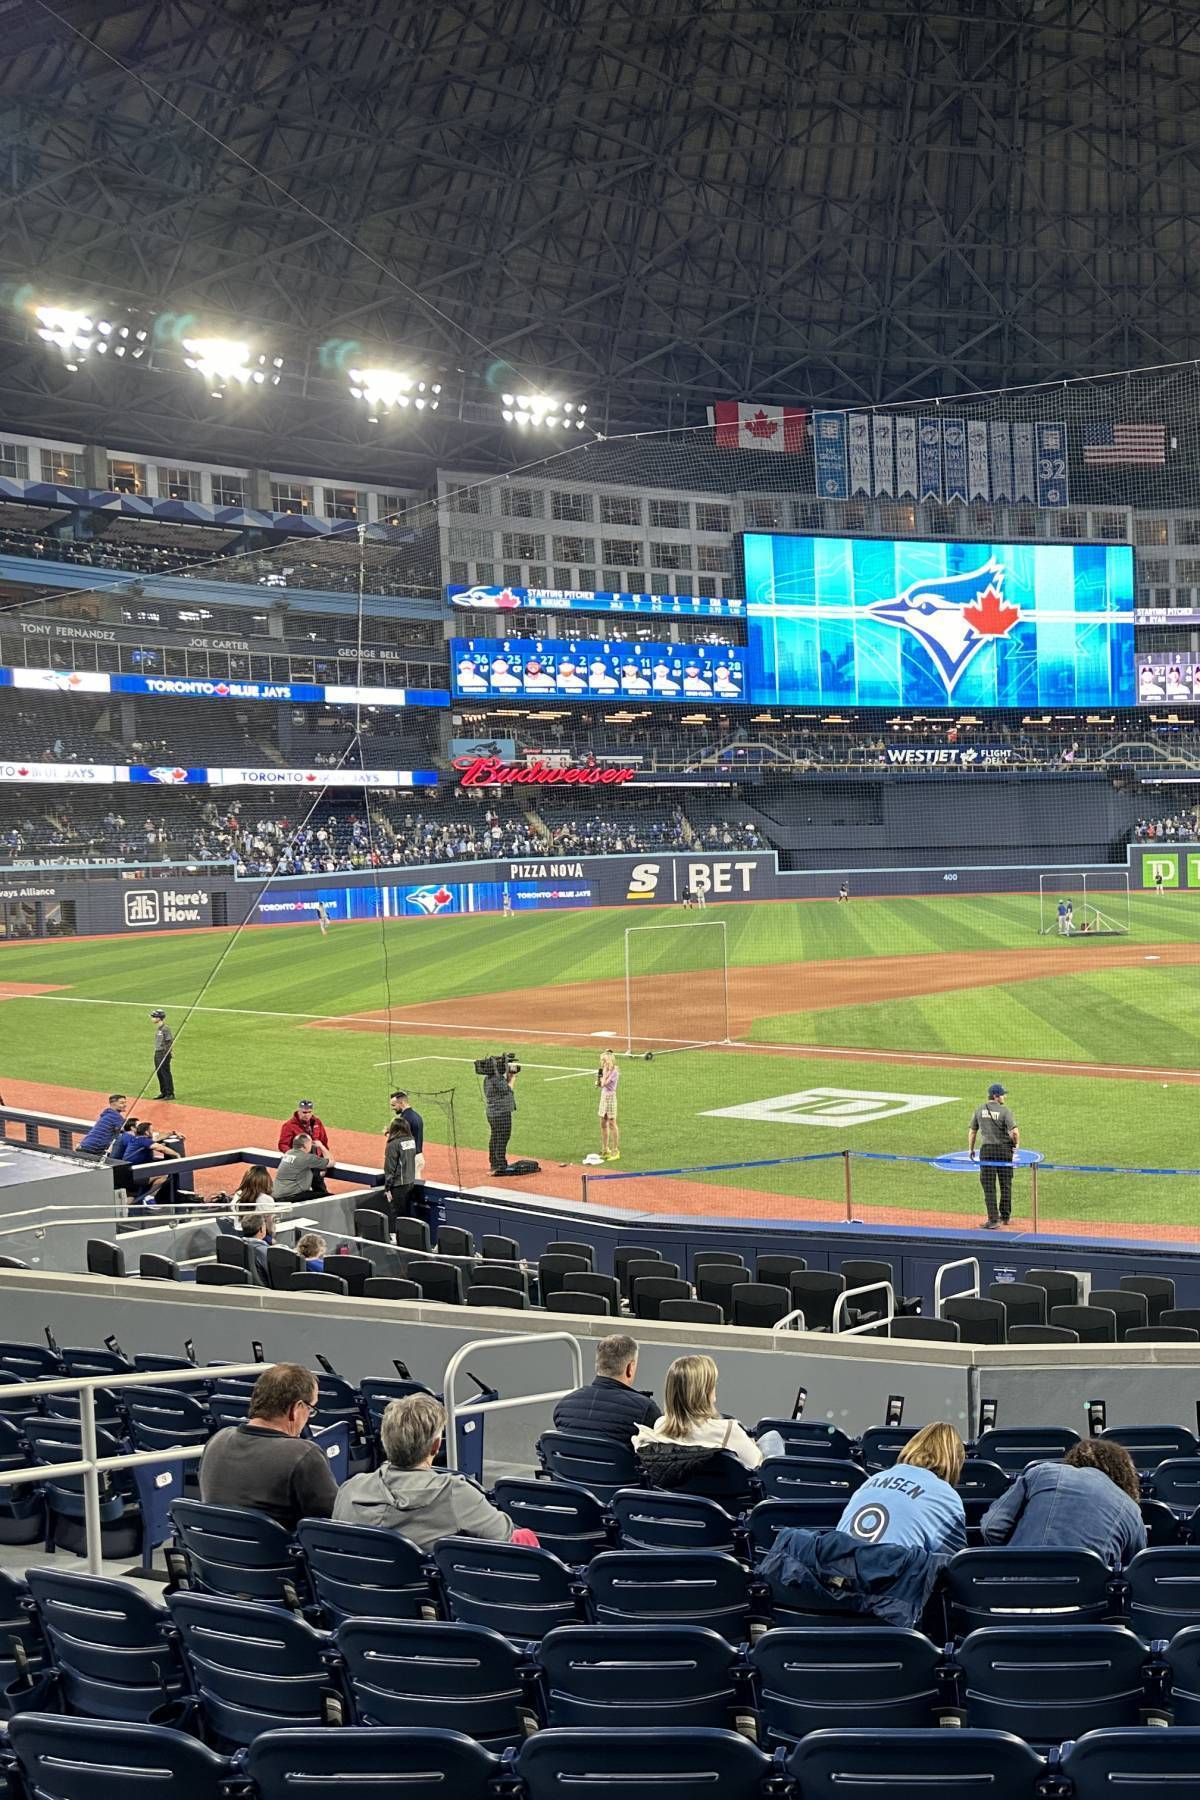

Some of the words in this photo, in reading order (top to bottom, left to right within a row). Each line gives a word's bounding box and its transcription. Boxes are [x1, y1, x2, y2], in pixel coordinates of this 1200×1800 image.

[1040, 459, 1066, 479] 32
[527, 589, 562, 599] STARTING
[1137, 607, 1166, 616] STARTING
[20, 623, 52, 634] TONY
[56, 626, 116, 641] FERNANDEZ
[188, 638, 208, 648] JOE
[212, 640, 249, 650] CARTER
[469, 642, 474, 651] 1
[503, 642, 510, 652] 2
[536, 643, 543, 652] 3
[667, 646, 673, 656] 7
[338, 649, 376, 658] GEORGE
[380, 651, 400, 659] BELL
[474, 655, 488, 664] 36
[507, 655, 521, 664] 25
[540, 656, 554, 665] 27
[579, 657, 586, 665] 2
[612, 657, 619, 666] 9
[641, 658, 650, 667] 11
[1147, 655, 1152, 664] 1
[1176, 655, 1181, 663] 2
[705, 661, 711, 670] 7
[728, 662, 741, 671] 28
[1186, 666, 1192, 674] 4
[1155, 667, 1166, 675] 27
[145, 679, 214, 696] TORONTO
[228, 683, 260, 697] BLUE
[261, 686, 292, 698] JAYS
[887, 749, 959, 765] WESTJET
[980, 749, 1012, 757] FLIGHT
[65, 768, 95, 778] JAYS
[452, 755, 635, 786] Budweiser
[241, 772, 303, 782] TORONTO
[511, 864, 547, 879] PIZZA
[550, 862, 584, 877] NOVA
[1147, 859, 1175, 881] TD
[629, 863, 660, 892] S
[688, 862, 757, 893] BET
[20, 888, 55, 896] Alliance
[517, 892, 551, 900] TORONTO
[163, 890, 209, 906] Here's
[259, 903, 295, 911] TORONTO
[303, 902, 320, 910] BLUE
[164, 907, 201, 922] How.
[767, 1095, 909, 1117] TD
[850, 1503, 889, 1543] 9
